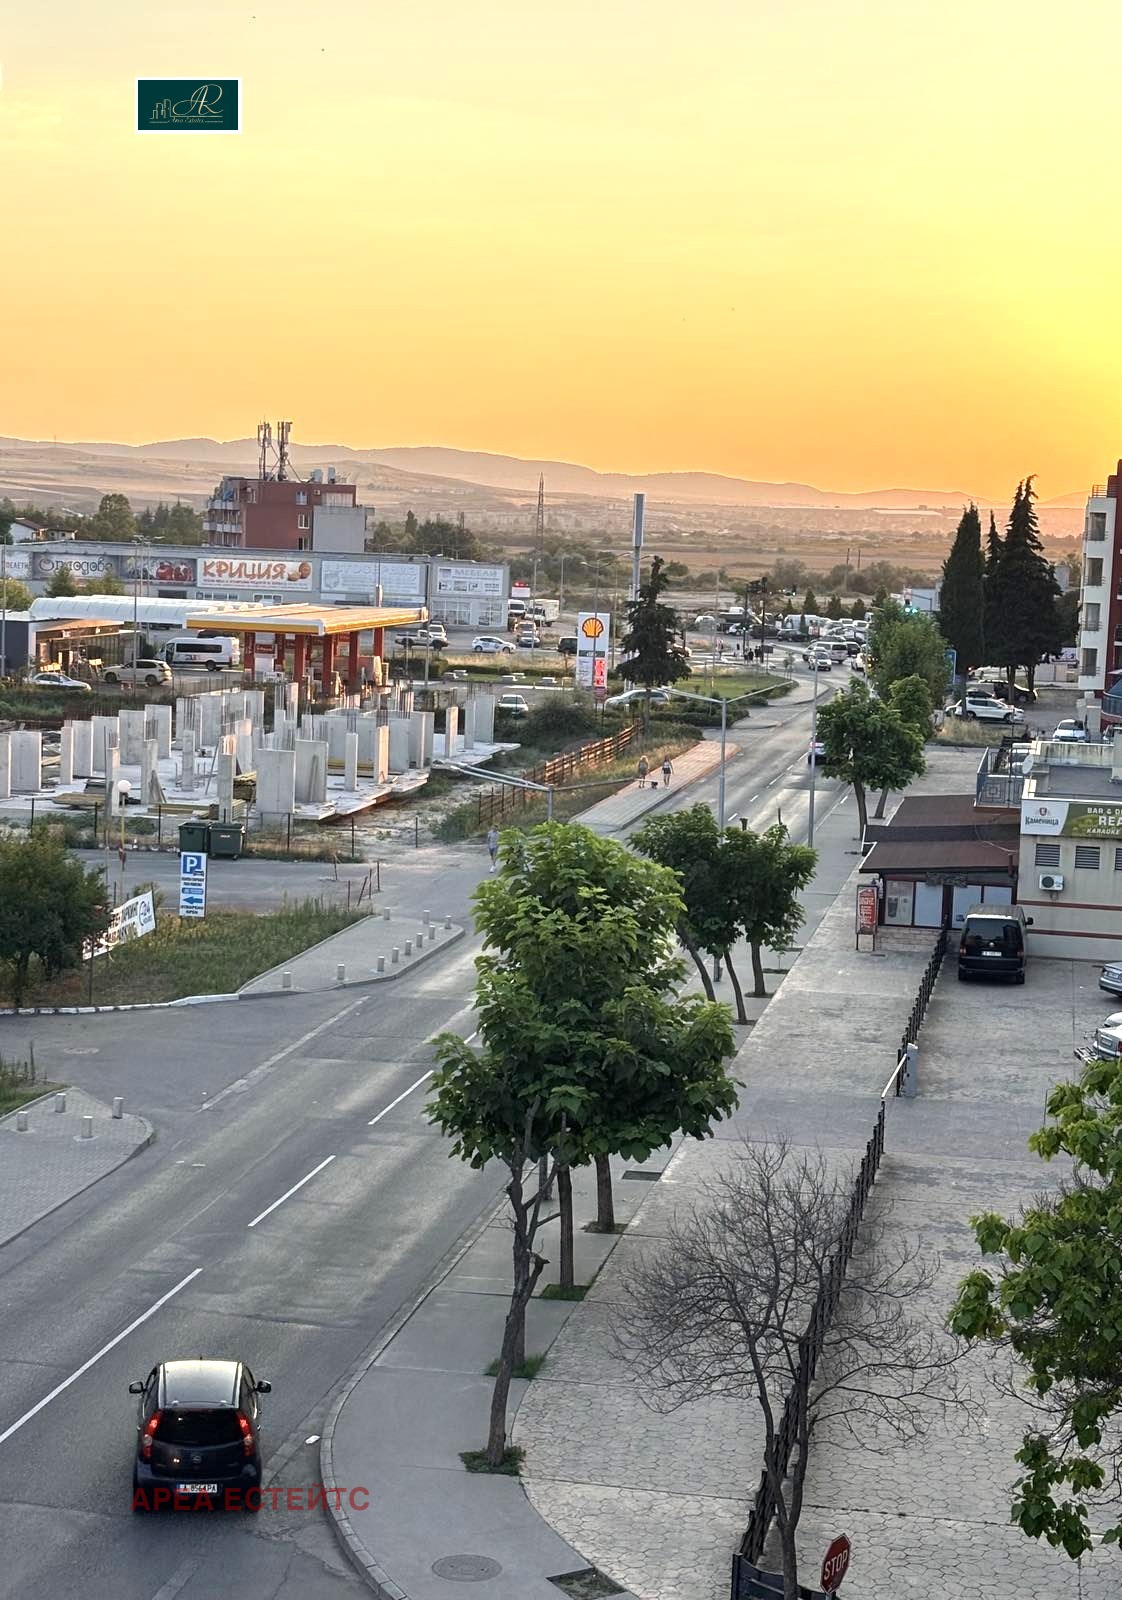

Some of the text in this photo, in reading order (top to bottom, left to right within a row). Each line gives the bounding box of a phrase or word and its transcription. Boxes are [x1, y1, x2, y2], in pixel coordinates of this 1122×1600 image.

[203, 560, 287, 580] КРИЦИЯ
[1087, 807, 1104, 815] BAR
[186, 856, 198, 873] P
[823, 1549, 848, 1580] STOP
